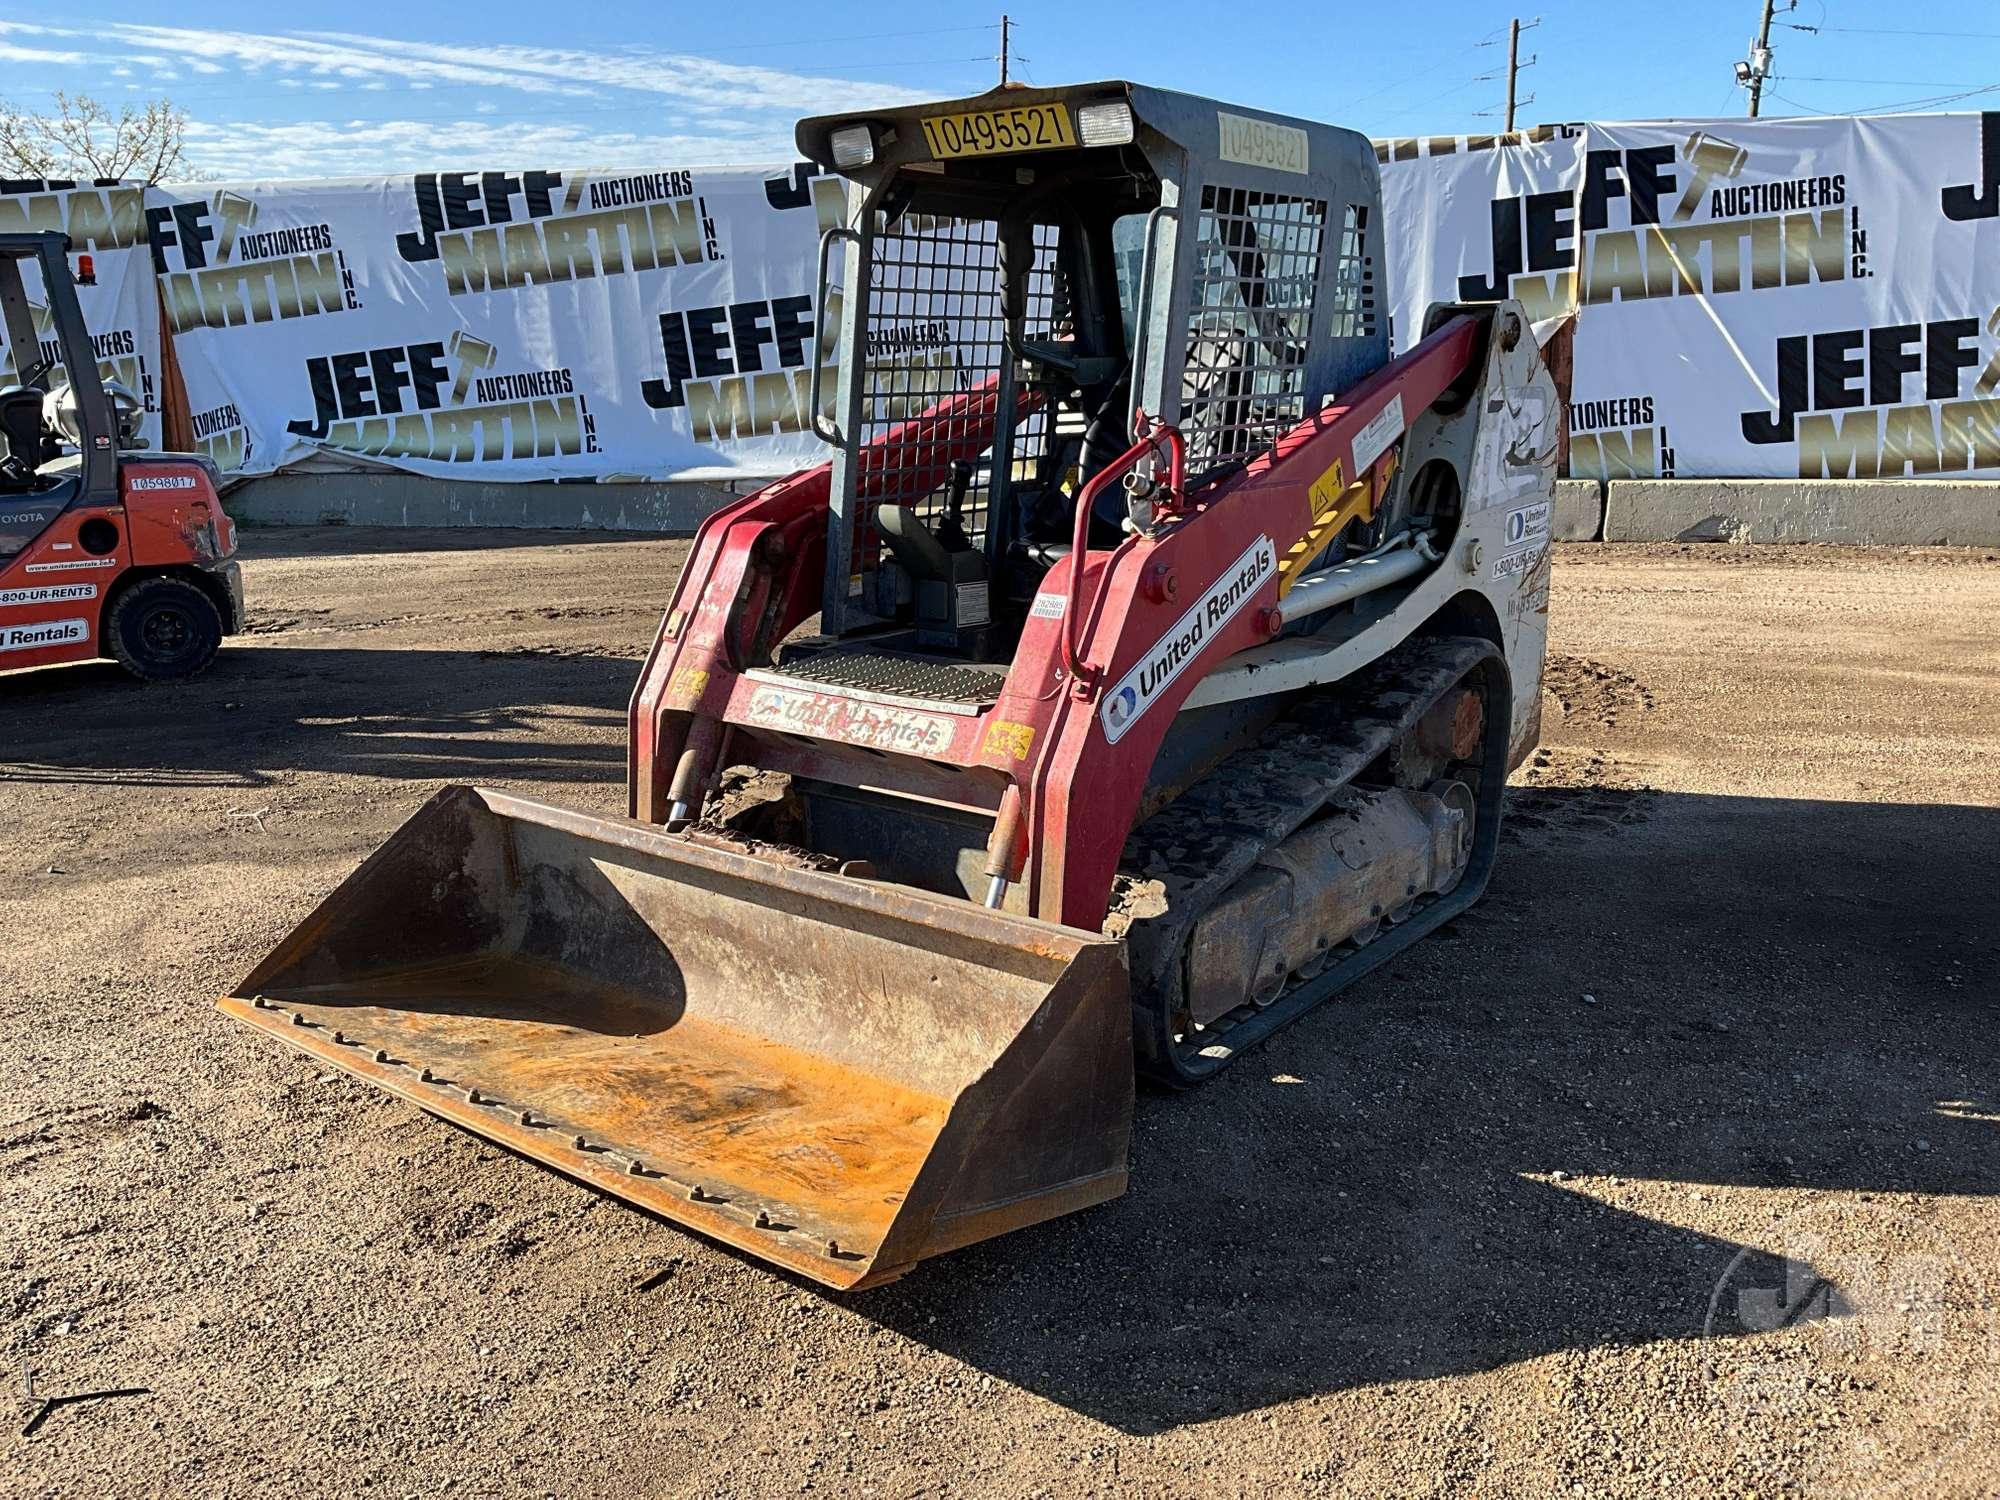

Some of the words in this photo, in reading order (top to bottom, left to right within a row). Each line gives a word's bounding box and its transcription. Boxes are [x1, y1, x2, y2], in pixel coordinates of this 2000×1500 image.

[925, 104, 1065, 155] 10495521
[1222, 116, 1303, 169] 10495521
[590, 171, 693, 209] AUCTIONEERS
[1711, 175, 1846, 218] AUCTIONEERS
[240, 224, 332, 261] AUCTIONEERS
[396, 171, 562, 262] JEFF
[440, 199, 704, 296] MARTIN
[641, 295, 815, 409] JEFF
[287, 342, 450, 440] JEFF
[476, 369, 573, 403] AUCTIONEERS
[1741, 317, 1979, 444] JEFF
[327, 397, 581, 463] MARTIN
[133, 478, 193, 488] 10598017
[0, 512, 45, 524] OYOTA
[10, 626, 78, 644] Rentals
[1139, 612, 1203, 698] United
[1206, 549, 1270, 630] Rentals
